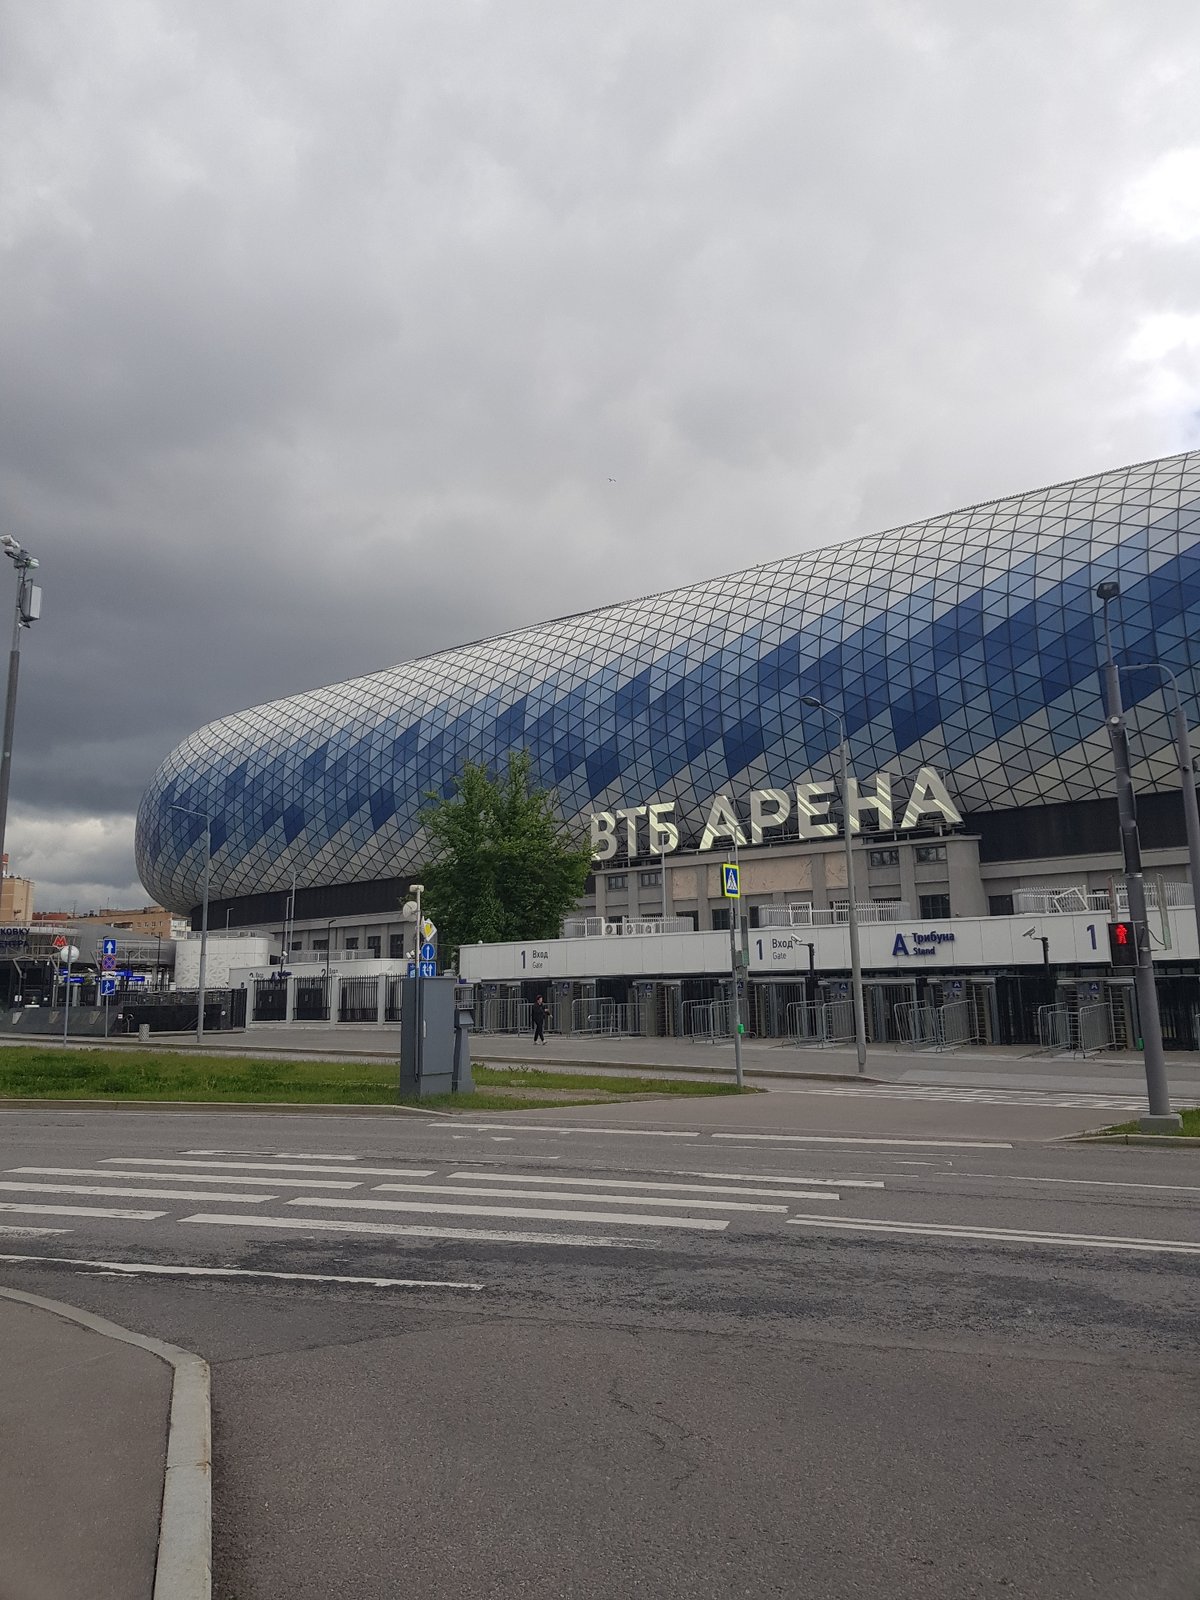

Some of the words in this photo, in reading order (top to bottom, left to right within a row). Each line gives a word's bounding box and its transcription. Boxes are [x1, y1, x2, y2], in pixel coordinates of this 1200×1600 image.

[590, 801, 679, 862] ВТБ
[699, 766, 964, 850] АРЕНА
[892, 933, 910, 956] А
[911, 930, 955, 945] Трибуна
[1086, 924, 1097, 950] 1
[521, 950, 526, 969] 1
[532, 950, 549, 960] Вход
[756, 939, 763, 961] 1
[771, 938, 794, 950] Вход
[772, 951, 787, 960] Gate
[912, 945, 936, 956] Stand
